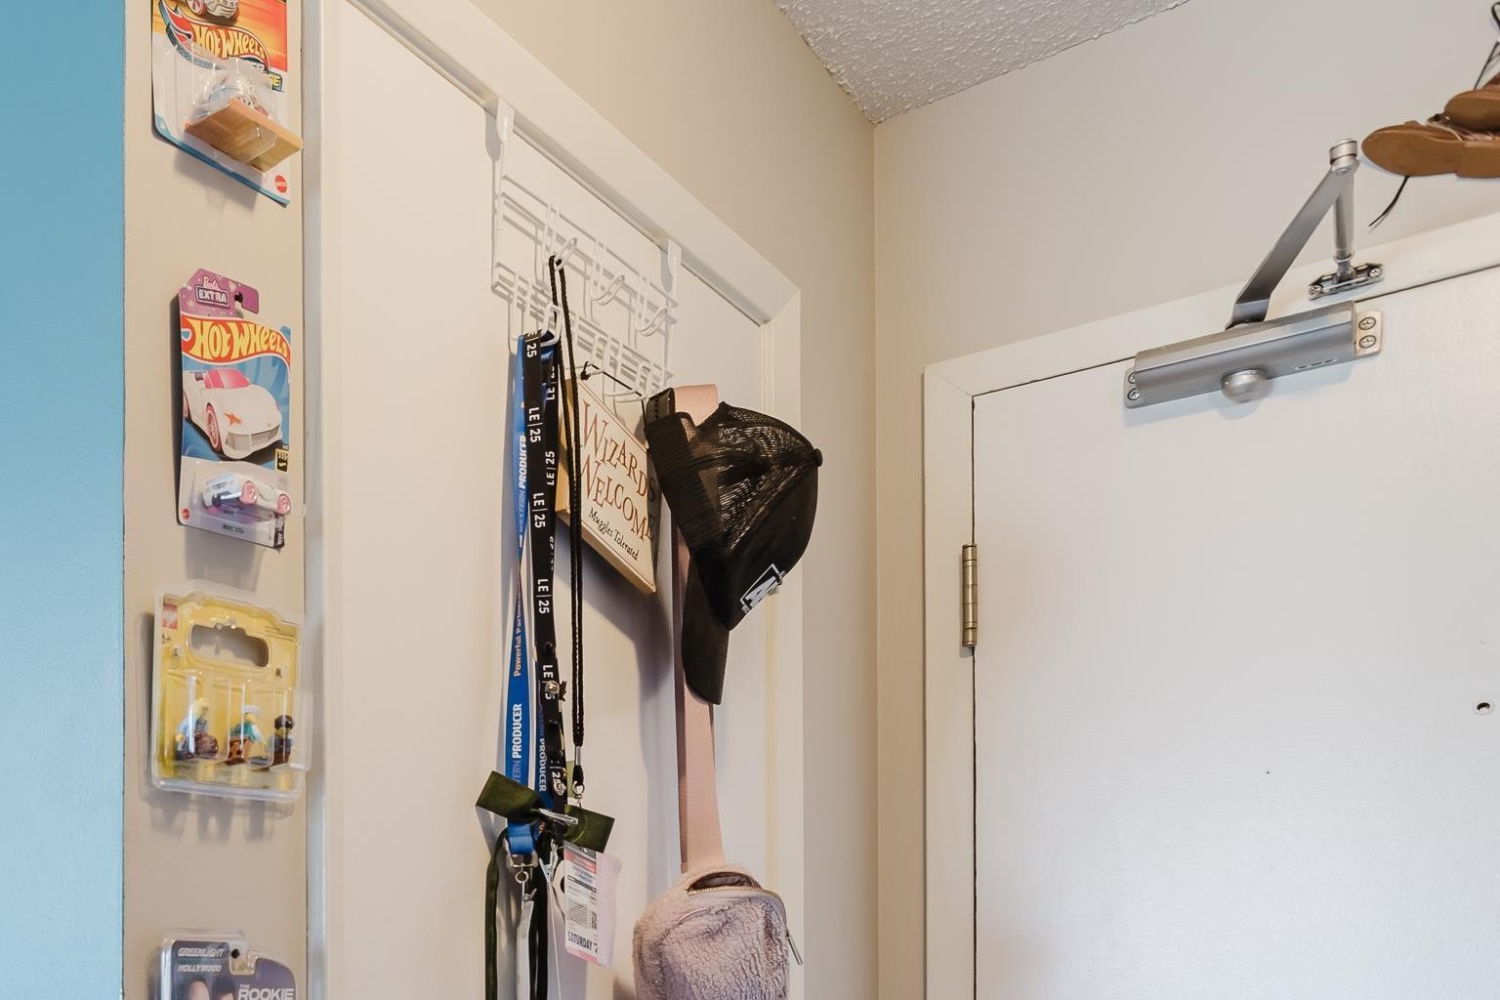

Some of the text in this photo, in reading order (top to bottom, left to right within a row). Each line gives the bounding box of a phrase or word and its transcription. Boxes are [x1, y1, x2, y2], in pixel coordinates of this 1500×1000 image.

[198, 288, 228, 303] EXTRA
[526, 342, 538, 358] 25
[545, 450, 556, 465] 25
[583, 398, 655, 504] WIZARDS
[533, 492, 546, 529] LE 25
[588, 506, 640, 562] Muggles Tolerated
[537, 578, 550, 614] LE 25
[513, 636, 522, 677] Powerful
[542, 664, 554, 678] LE
[512, 703, 523, 759] PRODUCER
[538, 738, 547, 792] PRODUCER
[567, 930, 593, 951] SATURDAY
[178, 964, 223, 973] HOLLYWOOD
